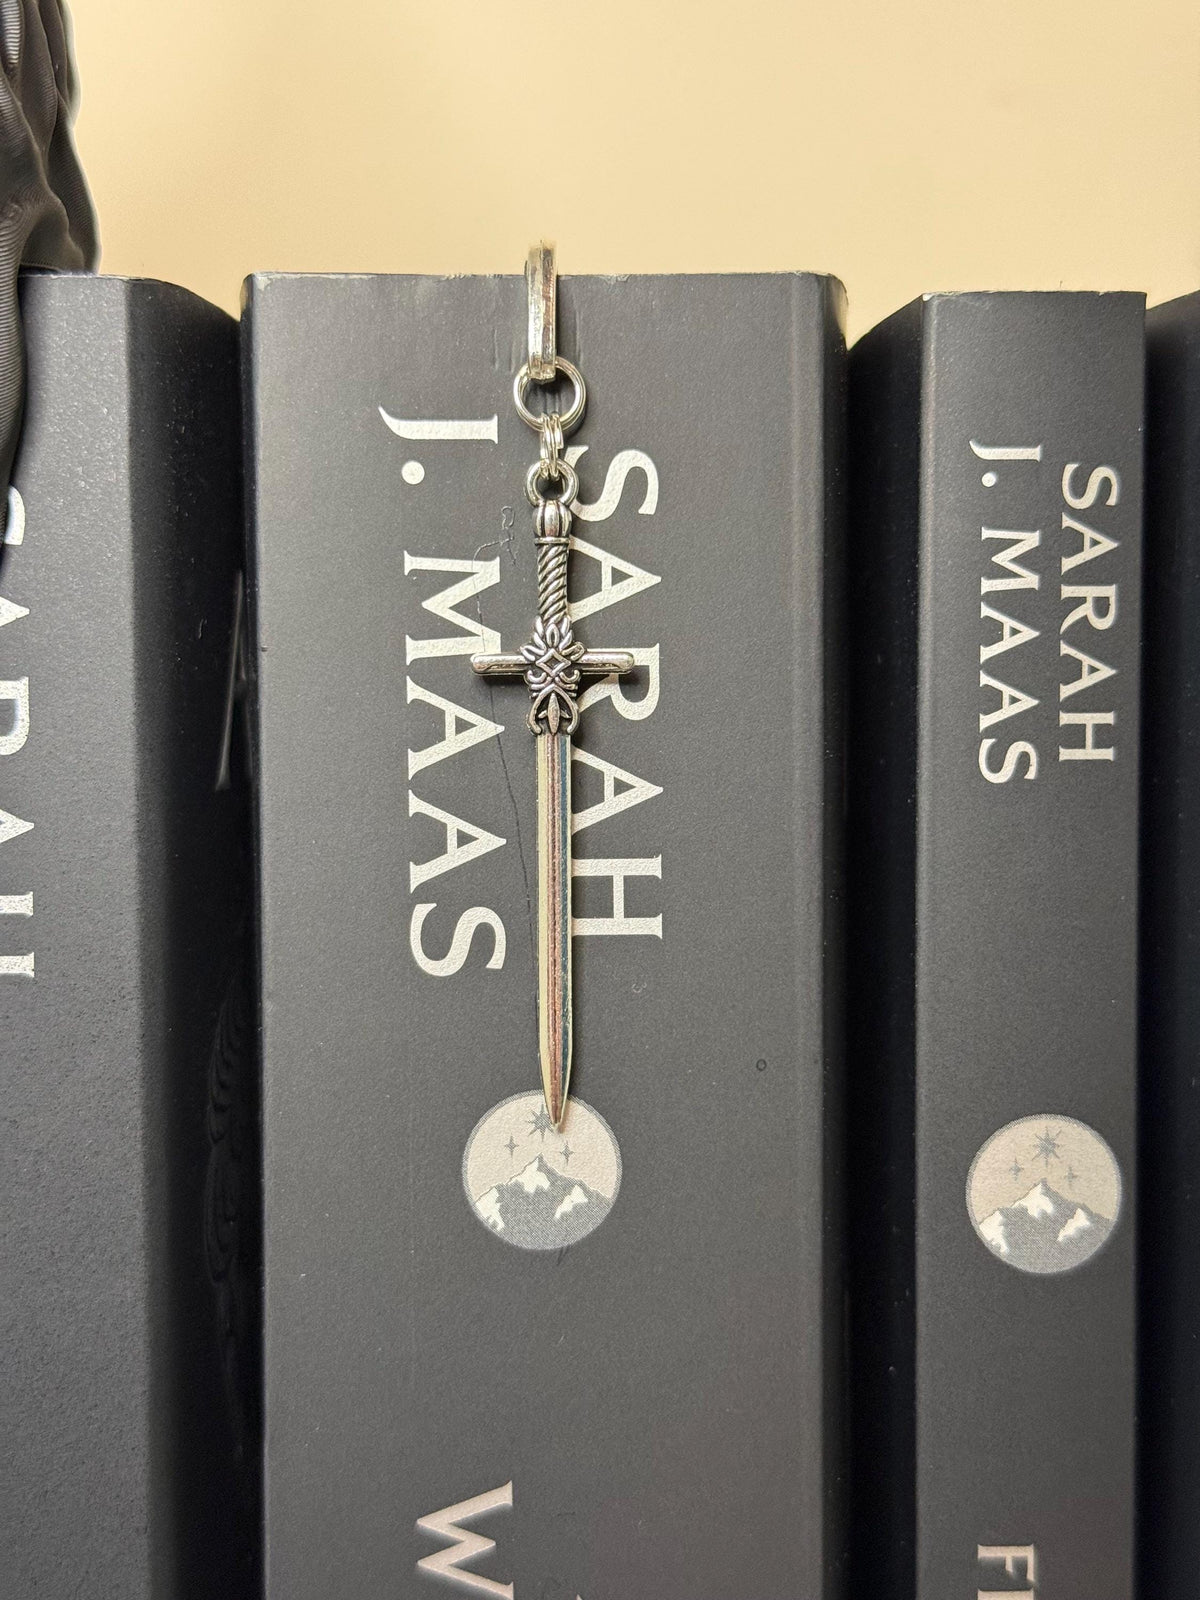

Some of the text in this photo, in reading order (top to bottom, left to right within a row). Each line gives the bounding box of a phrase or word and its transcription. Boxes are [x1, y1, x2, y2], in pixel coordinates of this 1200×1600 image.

[379, 406, 507, 978] J. MAAS
[566, 445, 664, 939] SARAH
[969, 439, 1041, 784] J. MAAS
[1059, 463, 1119, 762] SARAH
